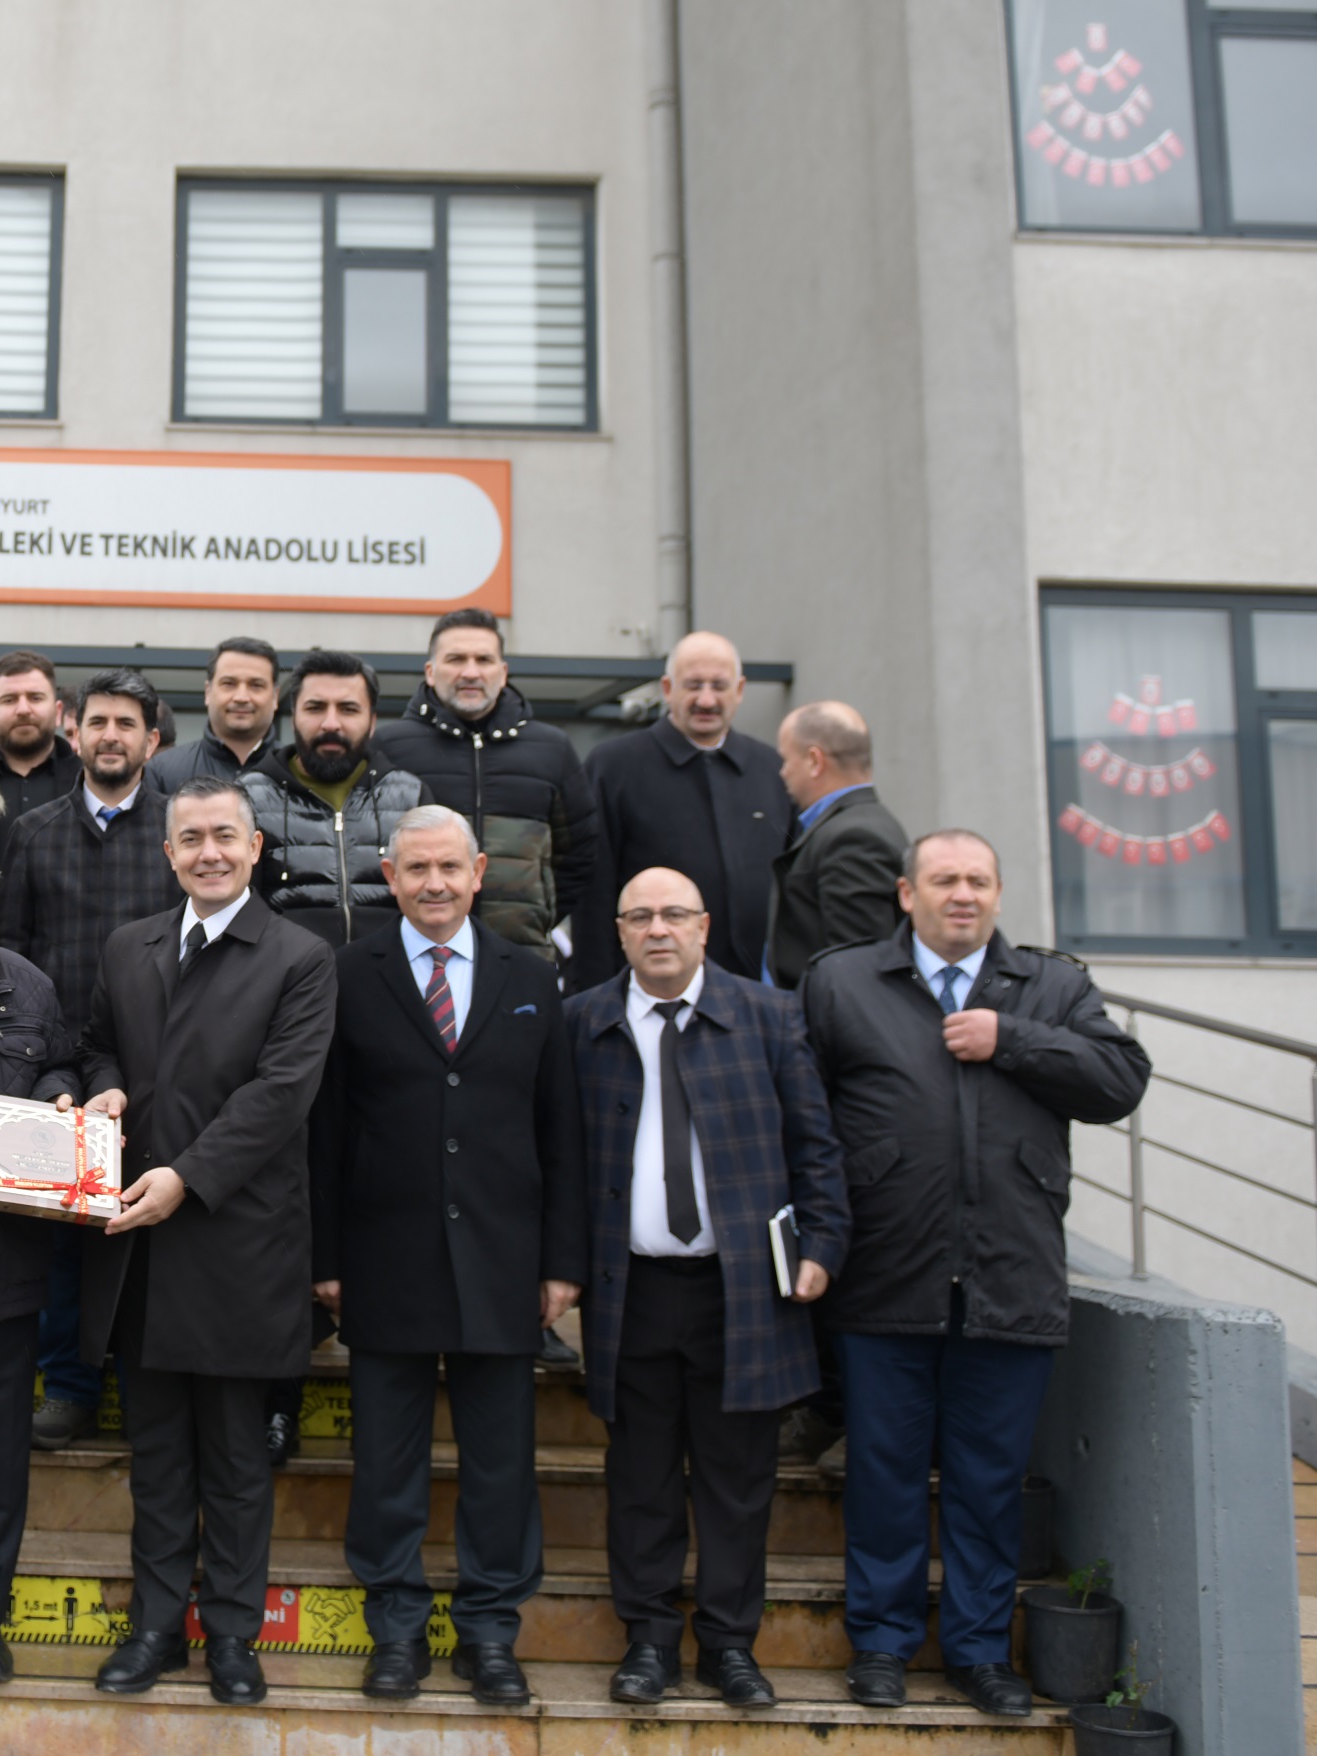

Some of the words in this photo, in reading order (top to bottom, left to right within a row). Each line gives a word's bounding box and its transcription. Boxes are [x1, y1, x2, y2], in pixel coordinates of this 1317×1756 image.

[60, 533, 94, 556] VE
[99, 530, 197, 560] TEKNİK
[203, 536, 339, 563] ANADOLU
[347, 535, 426, 566] LİSESİ
[23, 1600, 40, 1612] 1,5
